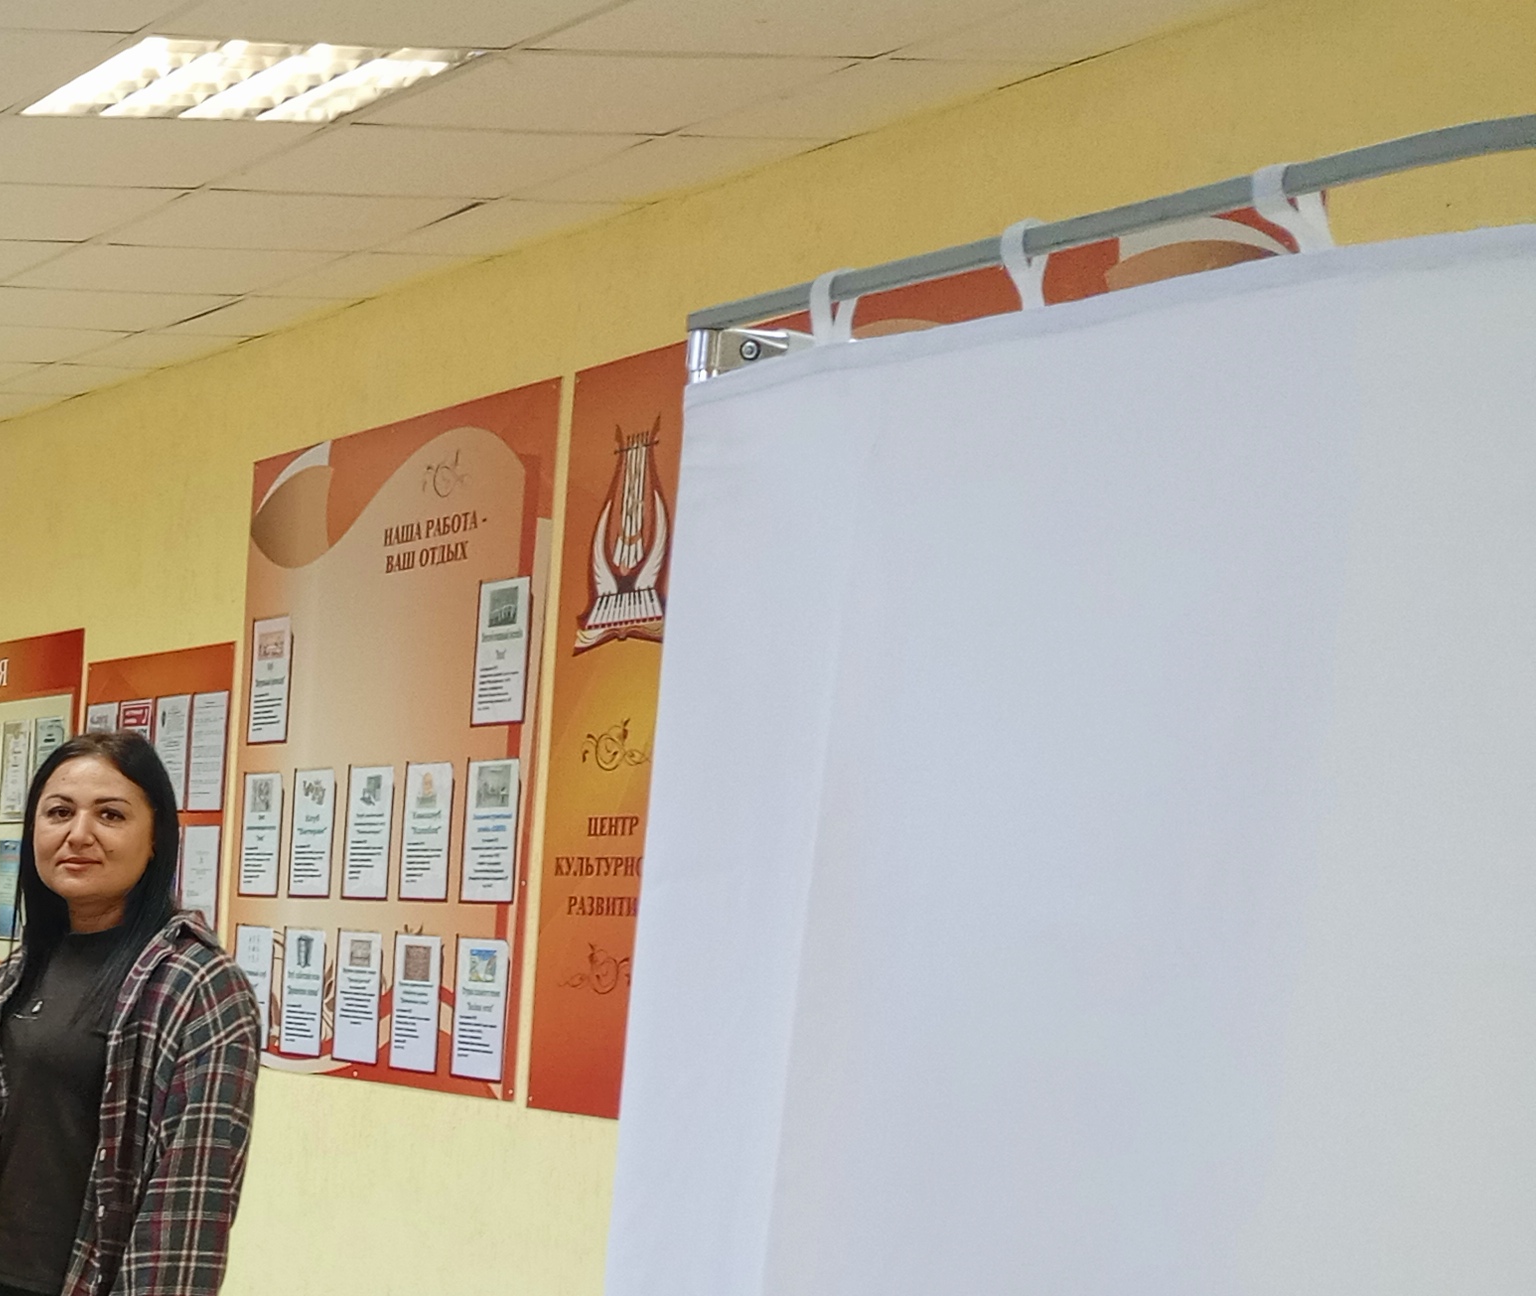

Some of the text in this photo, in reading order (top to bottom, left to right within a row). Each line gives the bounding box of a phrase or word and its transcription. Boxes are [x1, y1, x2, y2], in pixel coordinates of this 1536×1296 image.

[383, 521, 422, 547] НАША
[425, 510, 478, 539] РАБОТА
[385, 540, 469, 574] ВАШ ОТДЫХ
[587, 816, 639, 837] ЦЕНТР
[554, 856, 643, 877] КУЛЬТУРНО
[566, 895, 638, 917] РАЗВИТИ
